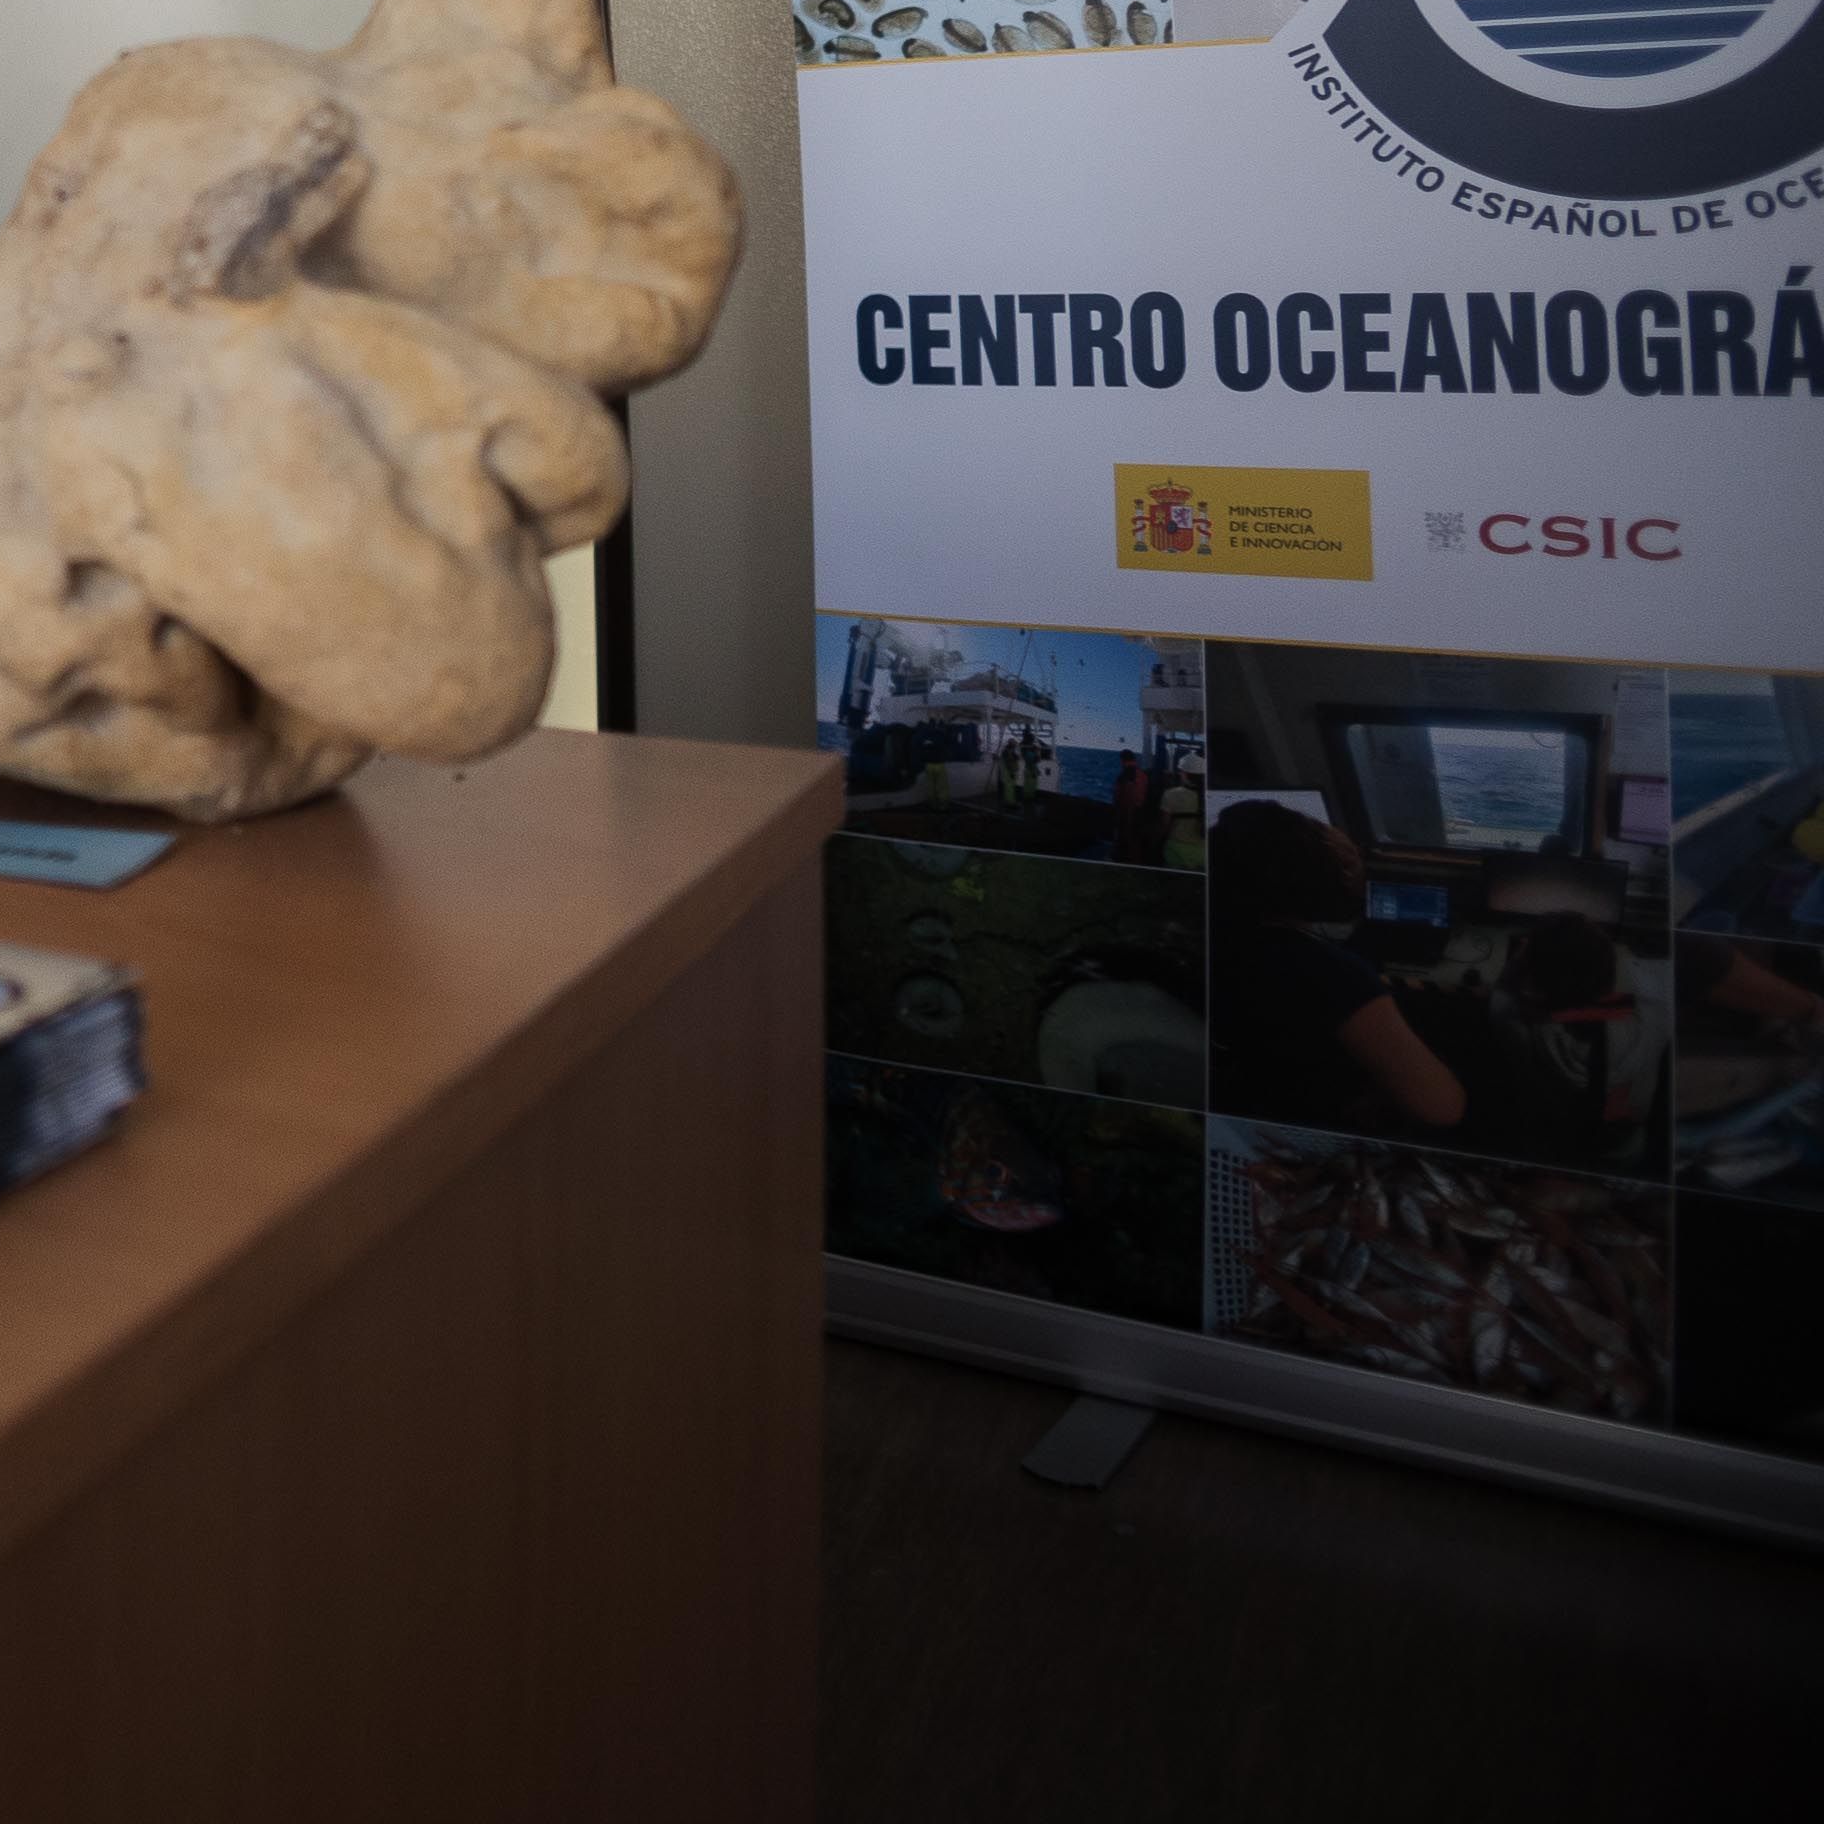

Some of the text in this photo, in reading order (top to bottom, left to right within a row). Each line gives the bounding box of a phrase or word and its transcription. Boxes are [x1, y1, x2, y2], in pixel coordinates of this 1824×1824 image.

[1288, 42, 1446, 194] INSTITUTO
[1451, 180, 1658, 238] ESPAÑOL
[1672, 198, 1734, 235] DE
[855, 265, 1824, 398] CENTRO OCEANOGRÁ
[1228, 504, 1313, 521] MINISTERIO
[1230, 520, 1315, 536] DE CIENCIA
[1229, 535, 1343, 553] E INNOVACIÓN
[1478, 512, 1683, 562] CSIC
